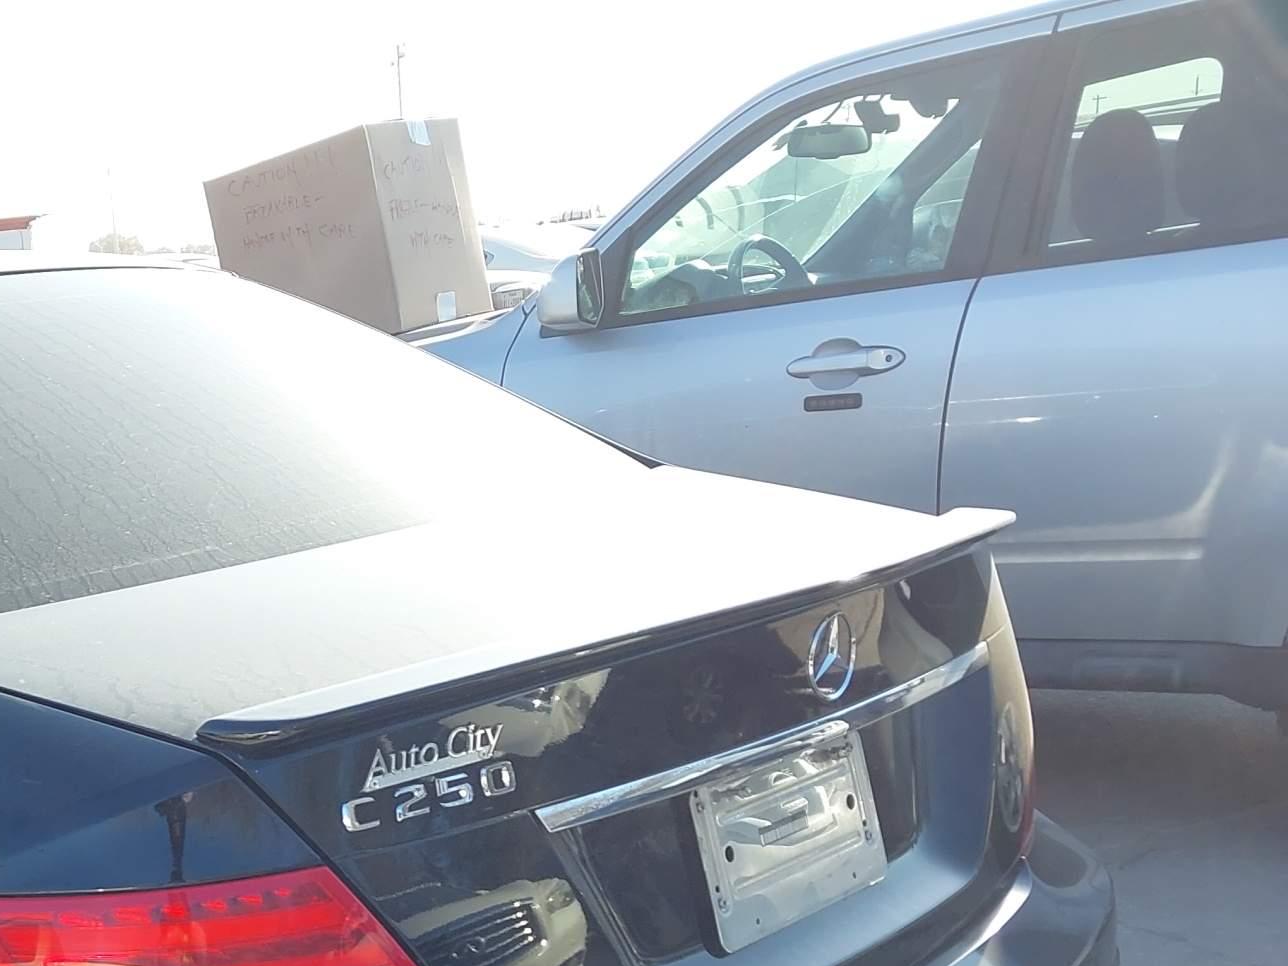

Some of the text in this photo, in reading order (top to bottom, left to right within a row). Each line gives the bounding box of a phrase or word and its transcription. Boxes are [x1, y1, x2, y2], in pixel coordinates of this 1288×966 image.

[227, 159, 302, 197] CAUTION
[362, 722, 505, 793] Auto City
[340, 759, 518, 833] C 250
